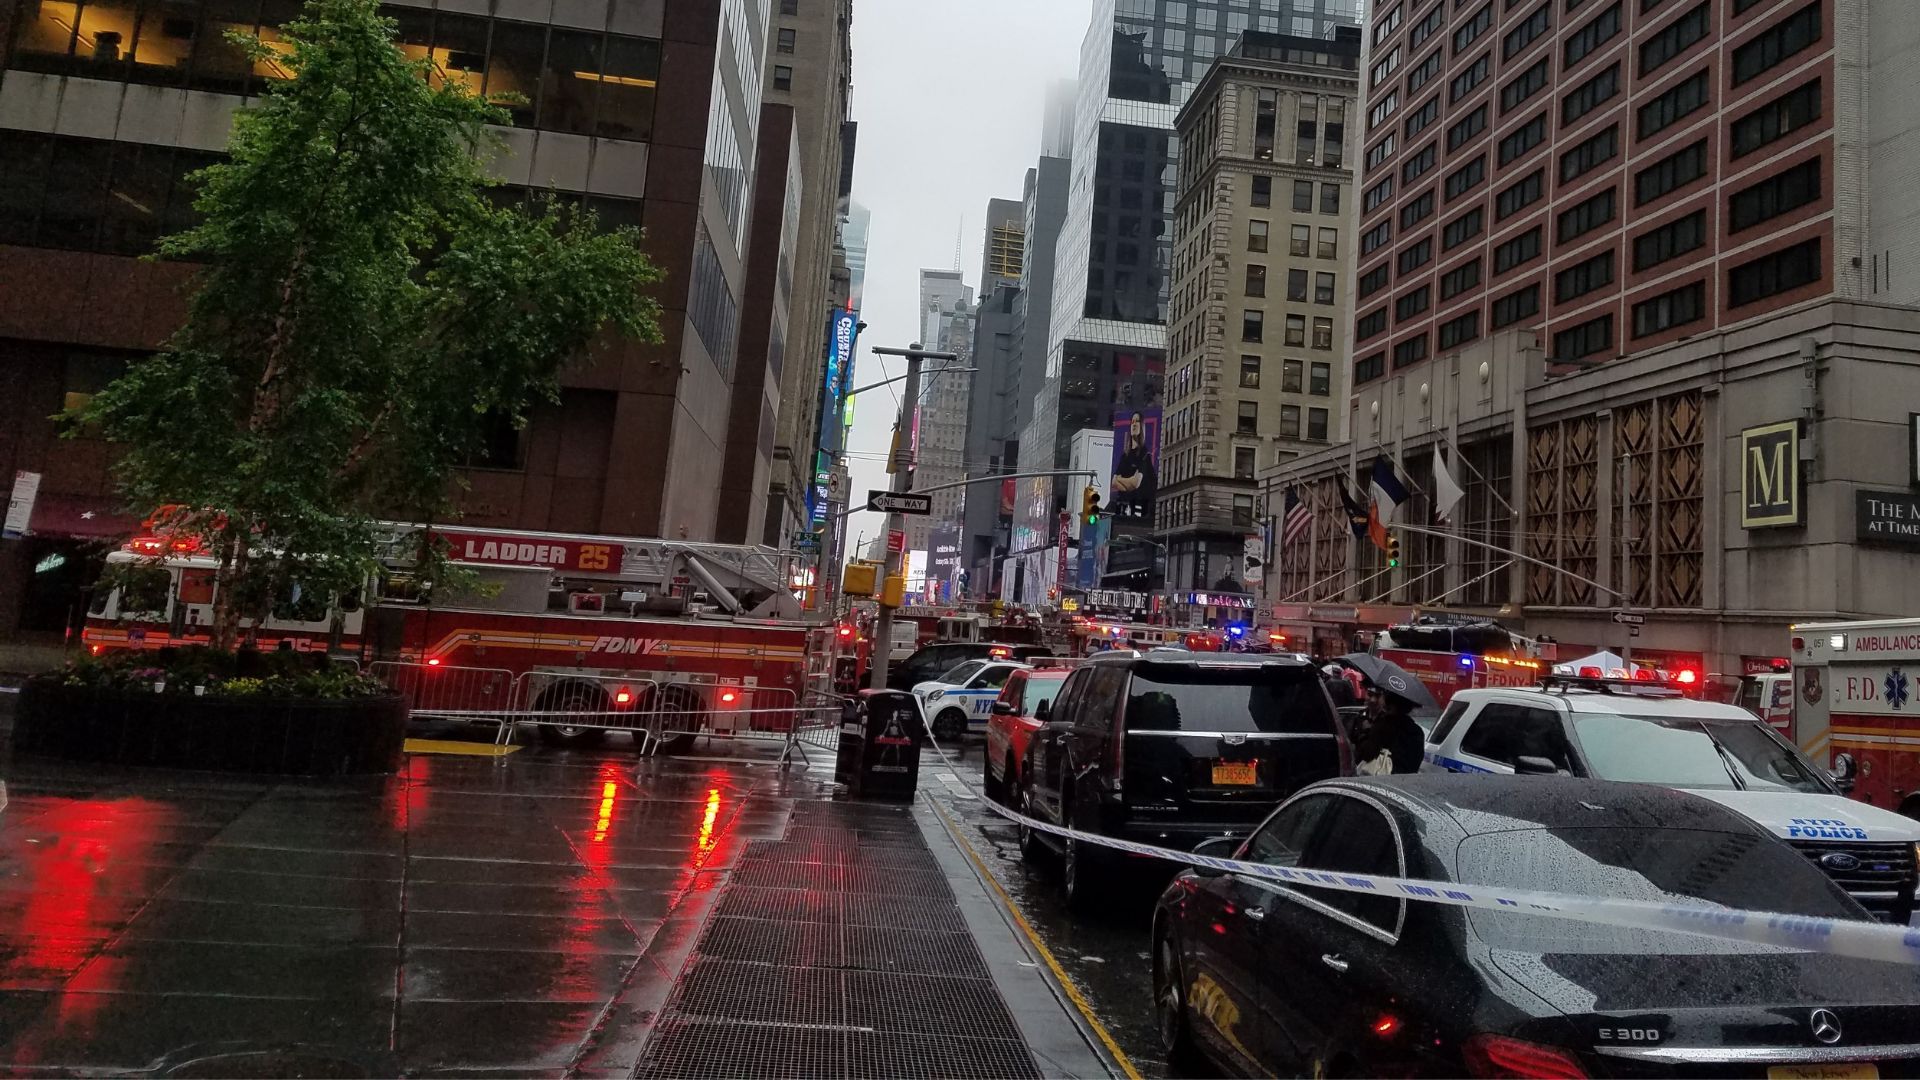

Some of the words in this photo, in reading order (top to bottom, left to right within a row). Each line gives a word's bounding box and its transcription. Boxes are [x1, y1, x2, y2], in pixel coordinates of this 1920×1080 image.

[1749, 441, 1789, 508] M
[877, 497, 896, 507] ONE
[904, 499, 924, 509] WAY
[1867, 499, 1904, 519] THE
[1868, 521, 1884, 531] AT
[464, 540, 567, 564] LADDER
[578, 545, 610, 570] 25
[1259, 608, 1271, 617] 25
[591, 636, 662, 655] FDNY
[1813, 638, 1825, 648] 057
[1847, 677, 1880, 701] F.D.
[1790, 818, 1847, 827] NYPD
[1786, 826, 1868, 840] POLICE
[1599, 1028, 1612, 1040] E
[1617, 1028, 1660, 1041] 300
